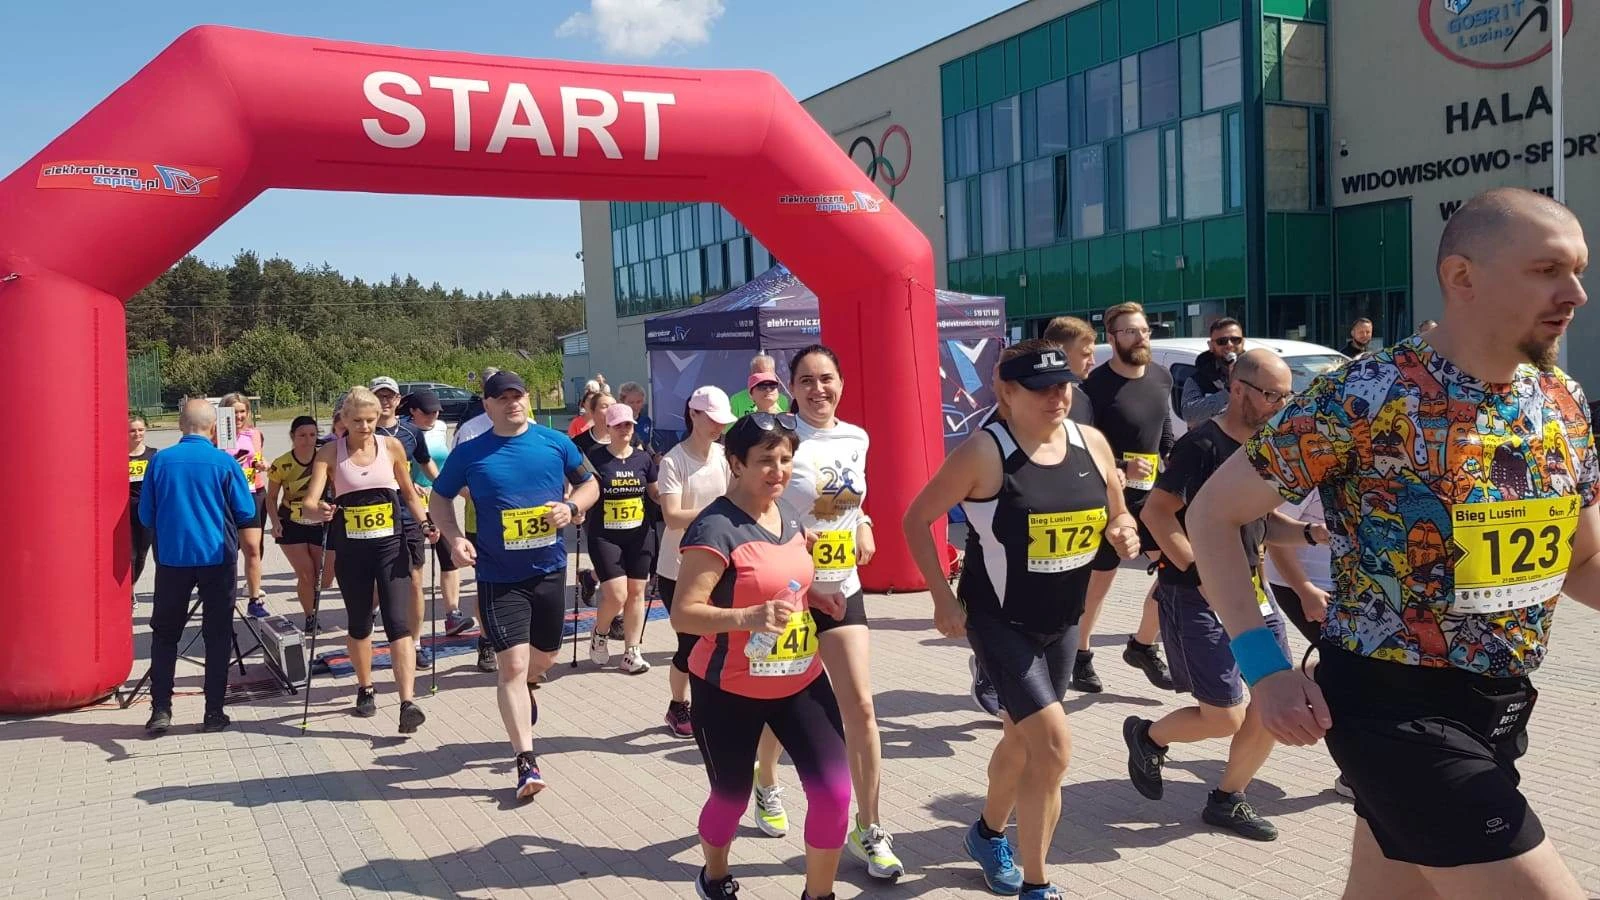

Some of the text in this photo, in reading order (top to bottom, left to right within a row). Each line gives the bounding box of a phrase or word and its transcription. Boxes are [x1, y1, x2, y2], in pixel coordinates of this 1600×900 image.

[361, 70, 676, 161] START
[1446, 86, 1553, 134] HALA
[1342, 130, 1600, 194] WIDOWISKOWO-SPOR
[44, 165, 139, 177] elektroniczne
[93, 175, 160, 191] zapisy.pl
[780, 194, 845, 205] elektroniczne
[816, 202, 857, 213] zapisy.pl
[612, 479, 641, 487] BEACH
[354, 513, 386, 529] 168
[612, 506, 638, 520] 157
[1031, 517, 1048, 525] Bieg
[1050, 515, 1073, 523] Lusini
[1455, 510, 1486, 523] Bieg
[1489, 506, 1526, 519] Lusini
[514, 516, 550, 537] 135
[1045, 525, 1094, 553] 172
[818, 543, 847, 565] 34
[1482, 525, 1561, 576] 123
